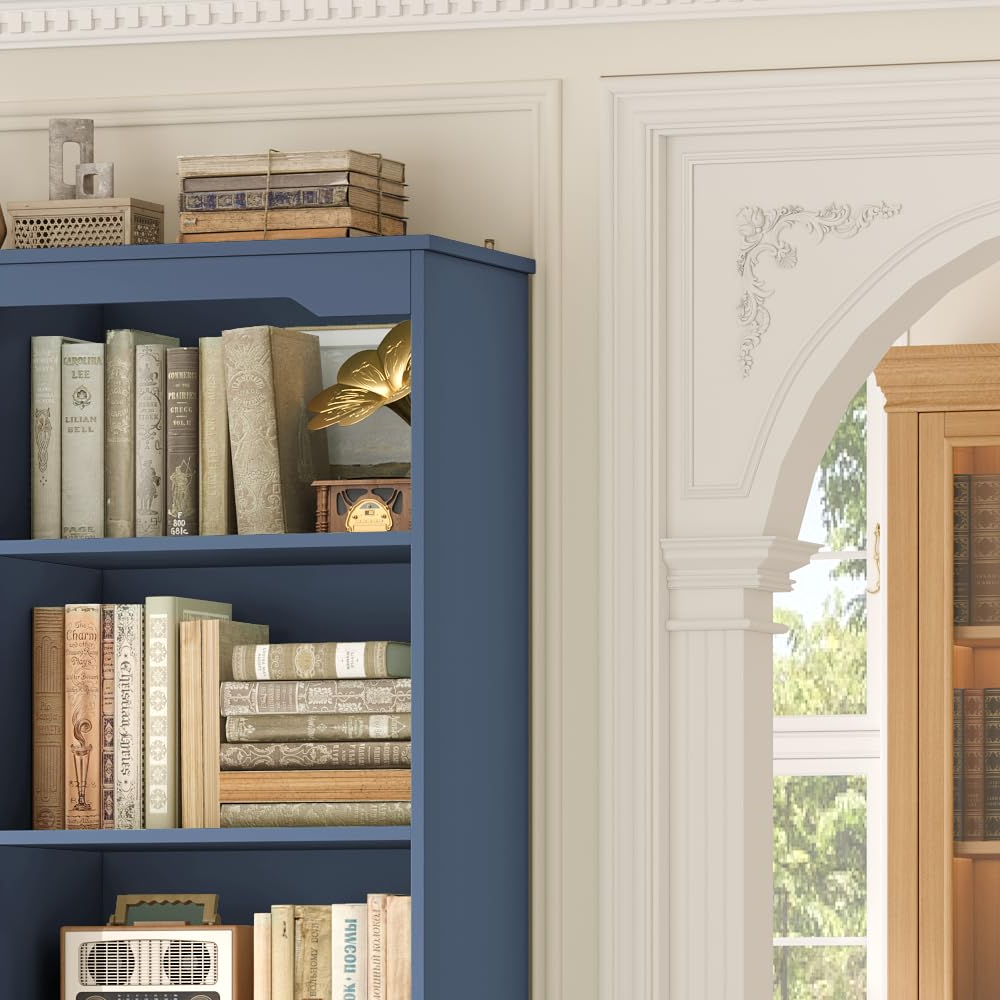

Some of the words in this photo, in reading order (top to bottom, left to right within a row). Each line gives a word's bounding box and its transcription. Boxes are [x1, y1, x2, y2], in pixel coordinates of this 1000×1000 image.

[71, 370, 91, 379] LEE
[170, 406, 193, 414] GREGG
[177, 511, 183, 519] F
[66, 629, 98, 641] Charm
[344, 918, 357, 973] ПОЭМЫ
